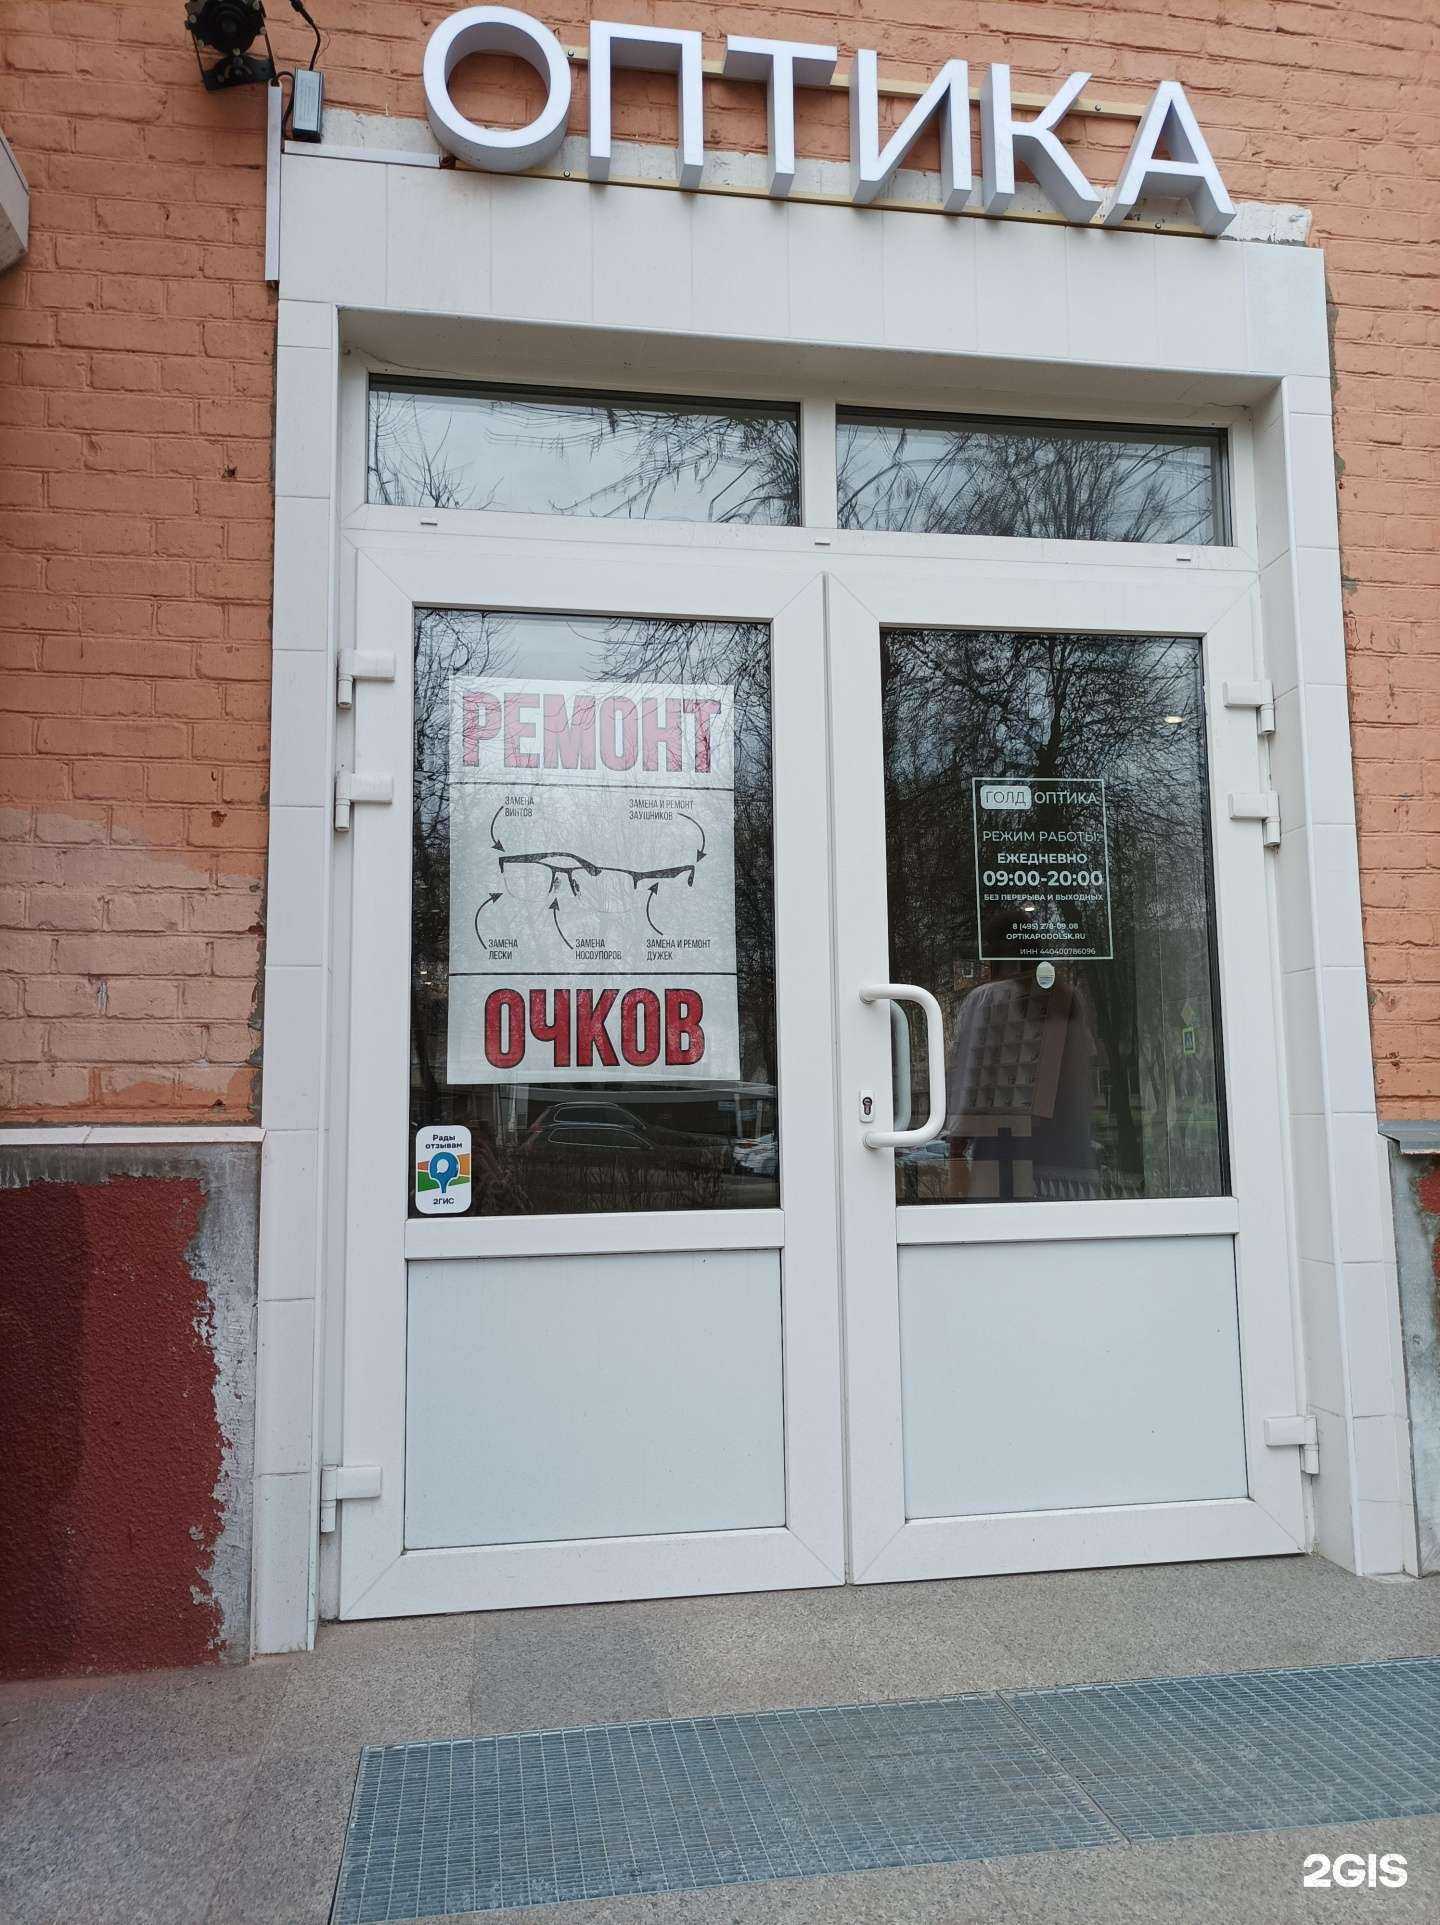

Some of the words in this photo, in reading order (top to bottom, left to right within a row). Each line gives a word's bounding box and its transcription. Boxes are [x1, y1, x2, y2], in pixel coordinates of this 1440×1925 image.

[423, 5, 1236, 237] ОПТИКА
[462, 692, 721, 773] РЕМОНТ
[504, 796, 535, 806] ЗАМЕНА
[985, 791, 1027, 806] ГОЛД
[1034, 791, 1098, 804] ОПТИКА
[629, 799, 659, 809] ЗАМЕНА
[660, 800, 666, 809] И
[667, 800, 694, 810] РЕМОНТ
[504, 807, 533, 817] ВИНТОВ
[629, 810, 673, 821] ЗАУШНИКОВ
[983, 831, 1035, 842] РЕЖИМ
[997, 853, 1088, 865] ЕЖЕДНЕВНО
[983, 870, 1103, 886] 09:00-20:00
[1055, 894, 1104, 902] ВЫХОДНЫХ
[1019, 923, 1039, 931] (495)
[488, 938, 518, 948] ЗАМЕНА
[575, 938, 605, 948] ЗАМЕНА
[646, 938, 675, 949] ЗАМЕНА
[676, 939, 682, 948] И
[683, 939, 711, 949] РЕМОНТ
[488, 950, 512, 960] ЛЕСКИ
[575, 950, 622, 960] НОСОУПОРОВ
[646, 950, 673, 961] ДУЖЕК
[484, 988, 705, 1069] ОЧКОВ
